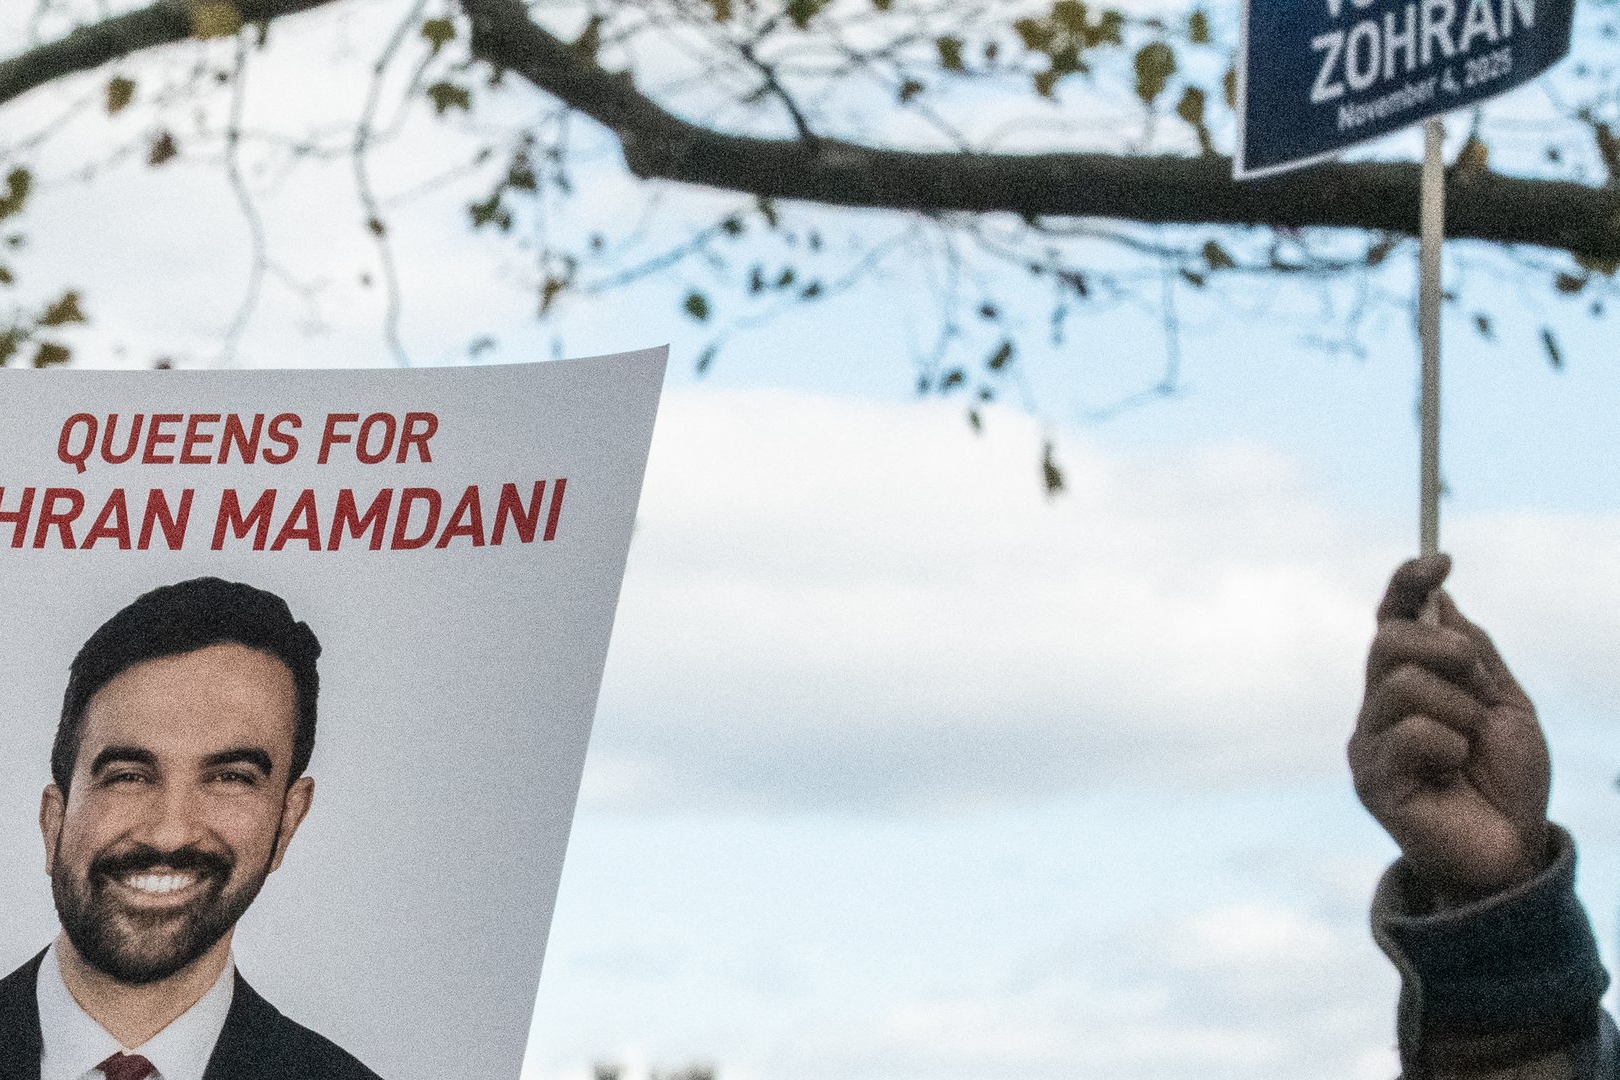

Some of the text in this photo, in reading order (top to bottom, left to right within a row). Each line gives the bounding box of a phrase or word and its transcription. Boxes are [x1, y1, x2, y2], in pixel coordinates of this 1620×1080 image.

[57, 412, 438, 474] QUEENS FOR
[210, 478, 568, 552] MAMDANI
